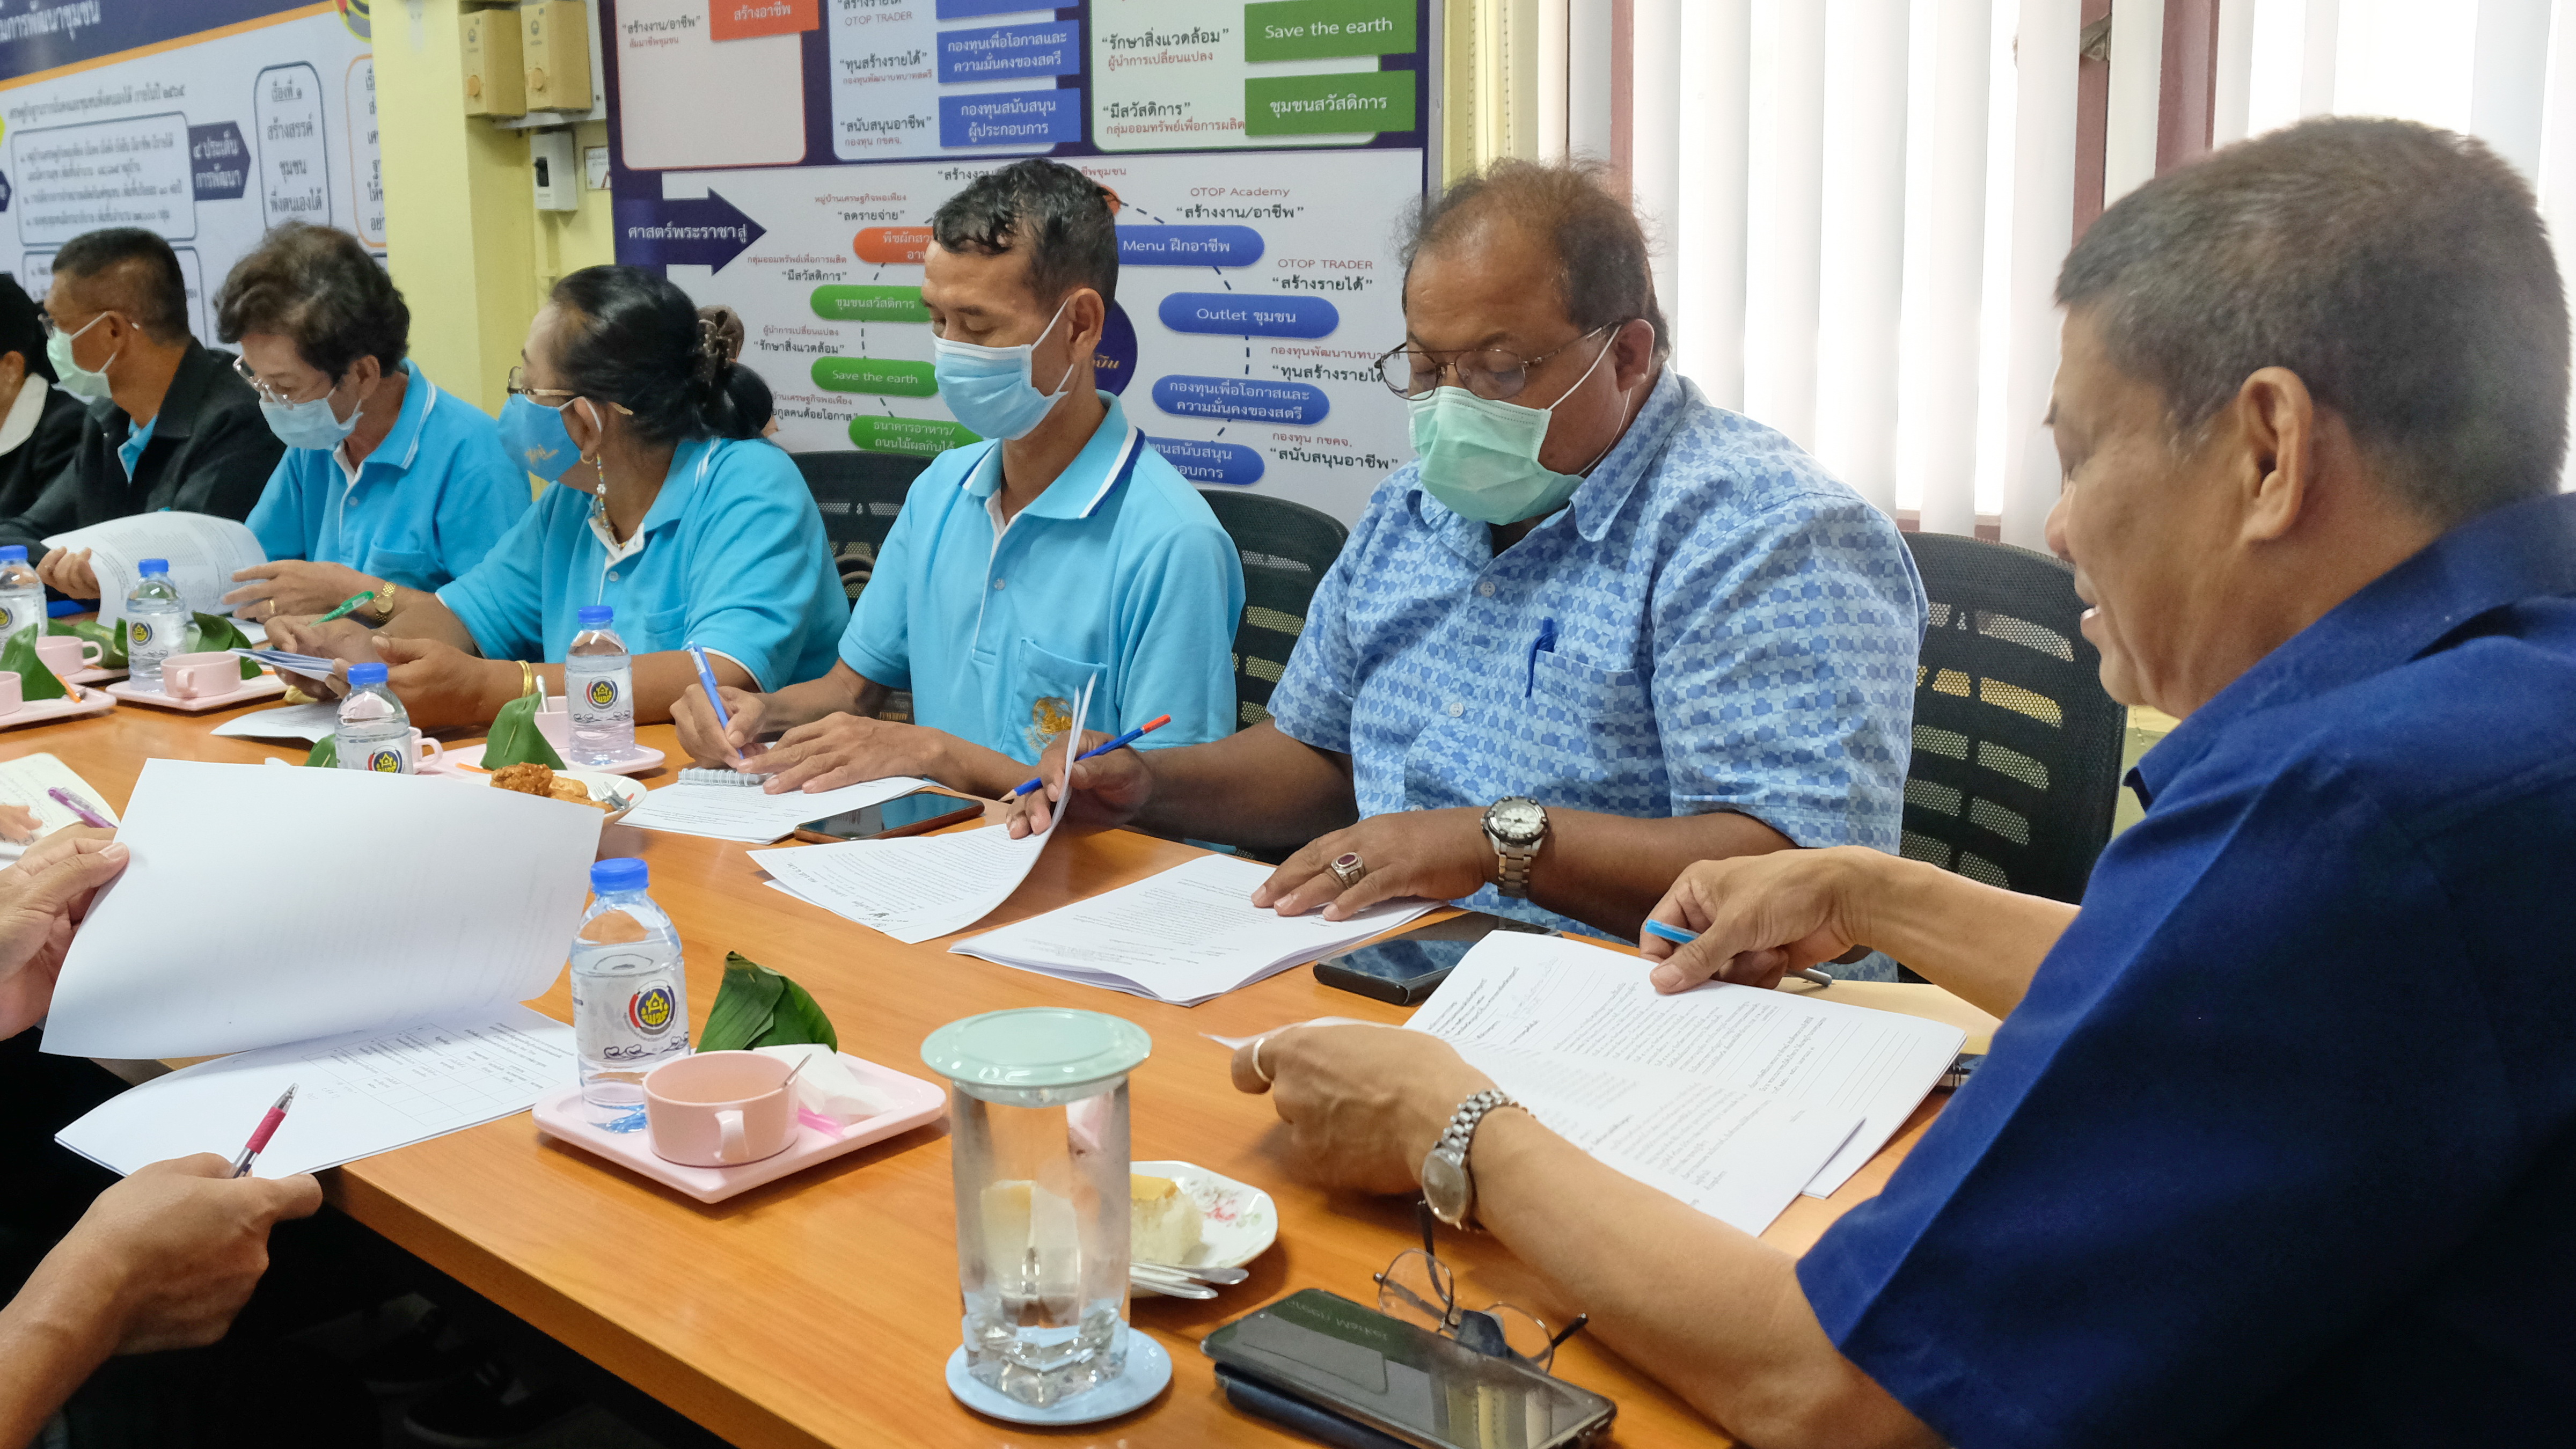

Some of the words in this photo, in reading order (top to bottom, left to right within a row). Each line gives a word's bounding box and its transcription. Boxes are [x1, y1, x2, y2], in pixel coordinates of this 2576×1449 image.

[734, 2, 791, 21] สร้างอาชีพ
[845, 15, 872, 26] OTOP
[875, 11, 912, 23] TRADER
[1265, 25, 1304, 39] Save
[1310, 21, 1340, 36] the
[1345, 17, 1393, 33] earth
[948, 32, 1067, 54] กองทุนเพื่อโอกาสและ
[954, 50, 1062, 73] ความมั่นคงของสตรี
[961, 99, 1057, 122] กองทุนสนับสนุน
[1270, 93, 1387, 118] ชุมชนสวัสดิการ
[968, 121, 1049, 143] ผู้ประกอบการ
[1081, 166, 1126, 179] ชีพชุมชน
[1190, 188, 1226, 196] OTOP
[1230, 188, 1290, 198] Academy
[627, 223, 748, 244] ศาสตร์พระราชาสู่
[1123, 241, 1165, 251] Menu
[1169, 238, 1230, 252] ฝึกอาชีพ
[1278, 259, 1315, 268] OTOP
[1320, 260, 1373, 269] TRADER
[835, 296, 916, 311] ชุมชนสวัสดิการ
[1196, 308, 1247, 321] Outlet
[1253, 311, 1297, 325] ชุมชน
[832, 370, 859, 380] Save
[863, 372, 883, 382] the
[887, 374, 918, 384] earth
[1169, 379, 1310, 400] กองทุนเพื่อโอกาสและ
[1177, 397, 1302, 420] ความมั่นคงของสตรี
[1272, 431, 1312, 446] กองทุน
